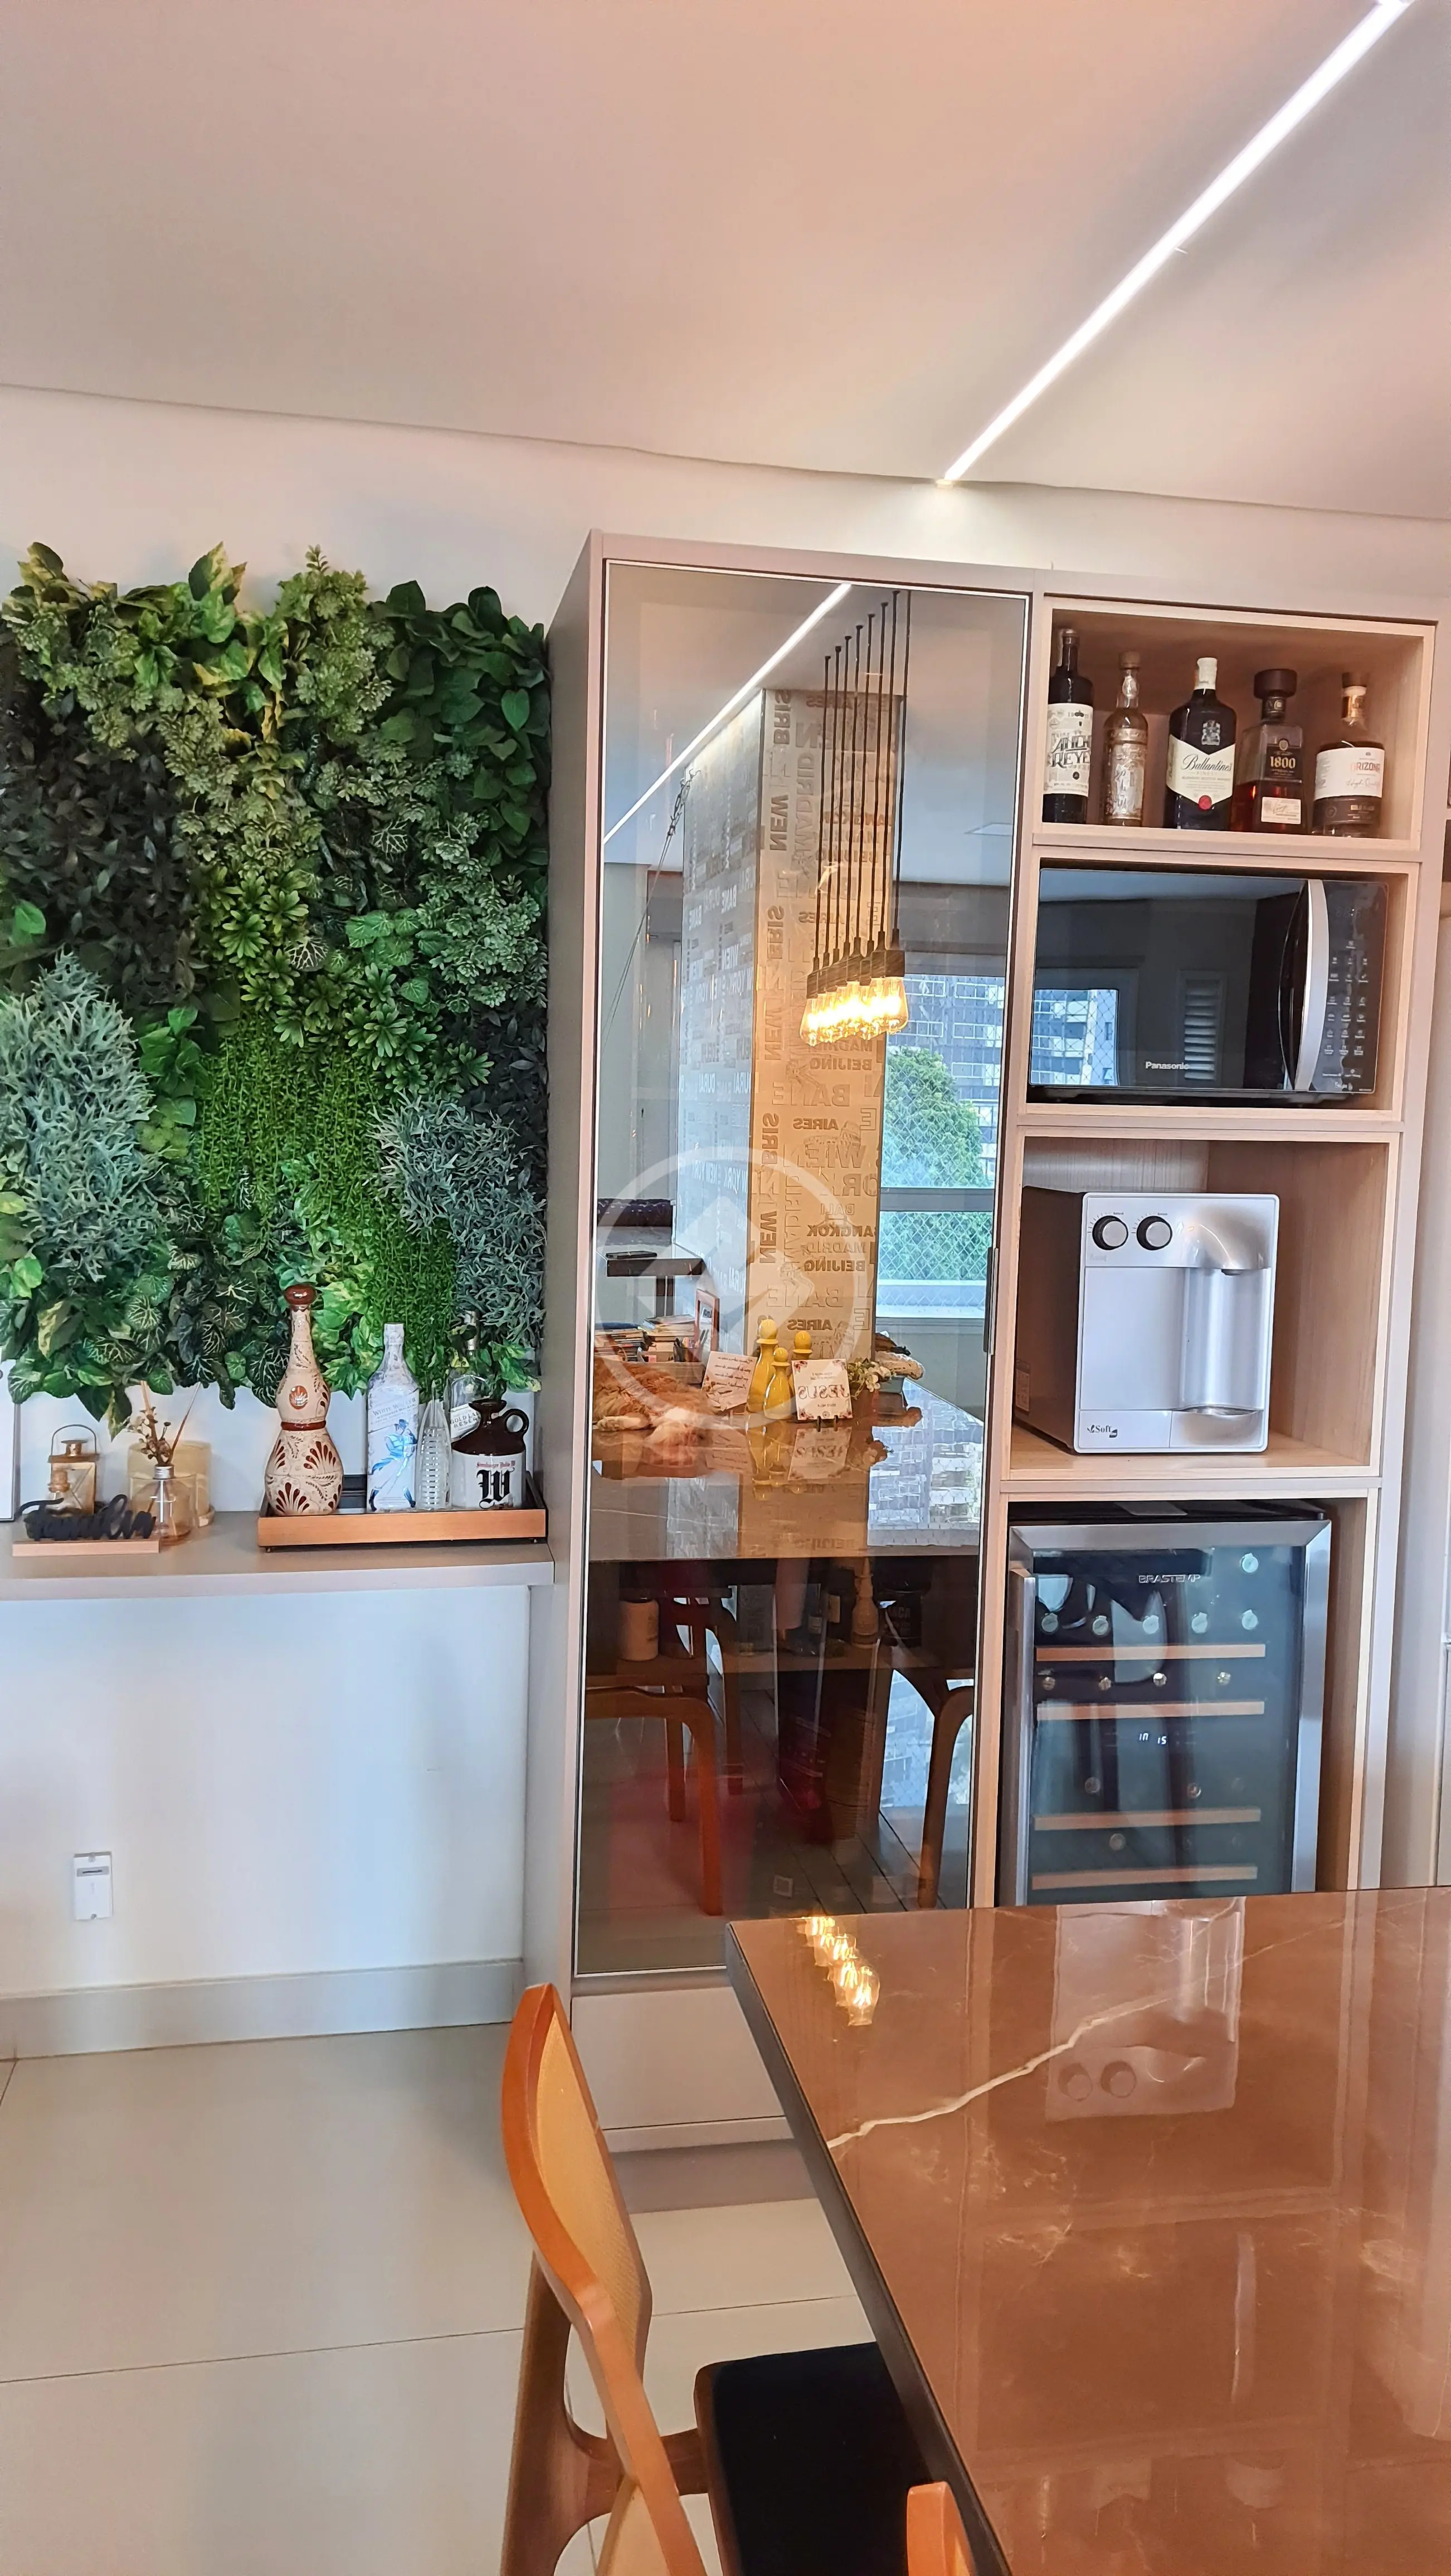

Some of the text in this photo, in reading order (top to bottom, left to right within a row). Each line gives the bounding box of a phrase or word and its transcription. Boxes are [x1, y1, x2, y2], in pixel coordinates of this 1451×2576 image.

[1270, 756, 1296, 769] 1800
[1145, 1061, 1190, 1070] Panasonic
[1095, 1424, 1112, 1433] Soft
[1138, 1574, 1201, 1584] BRASTEMP
